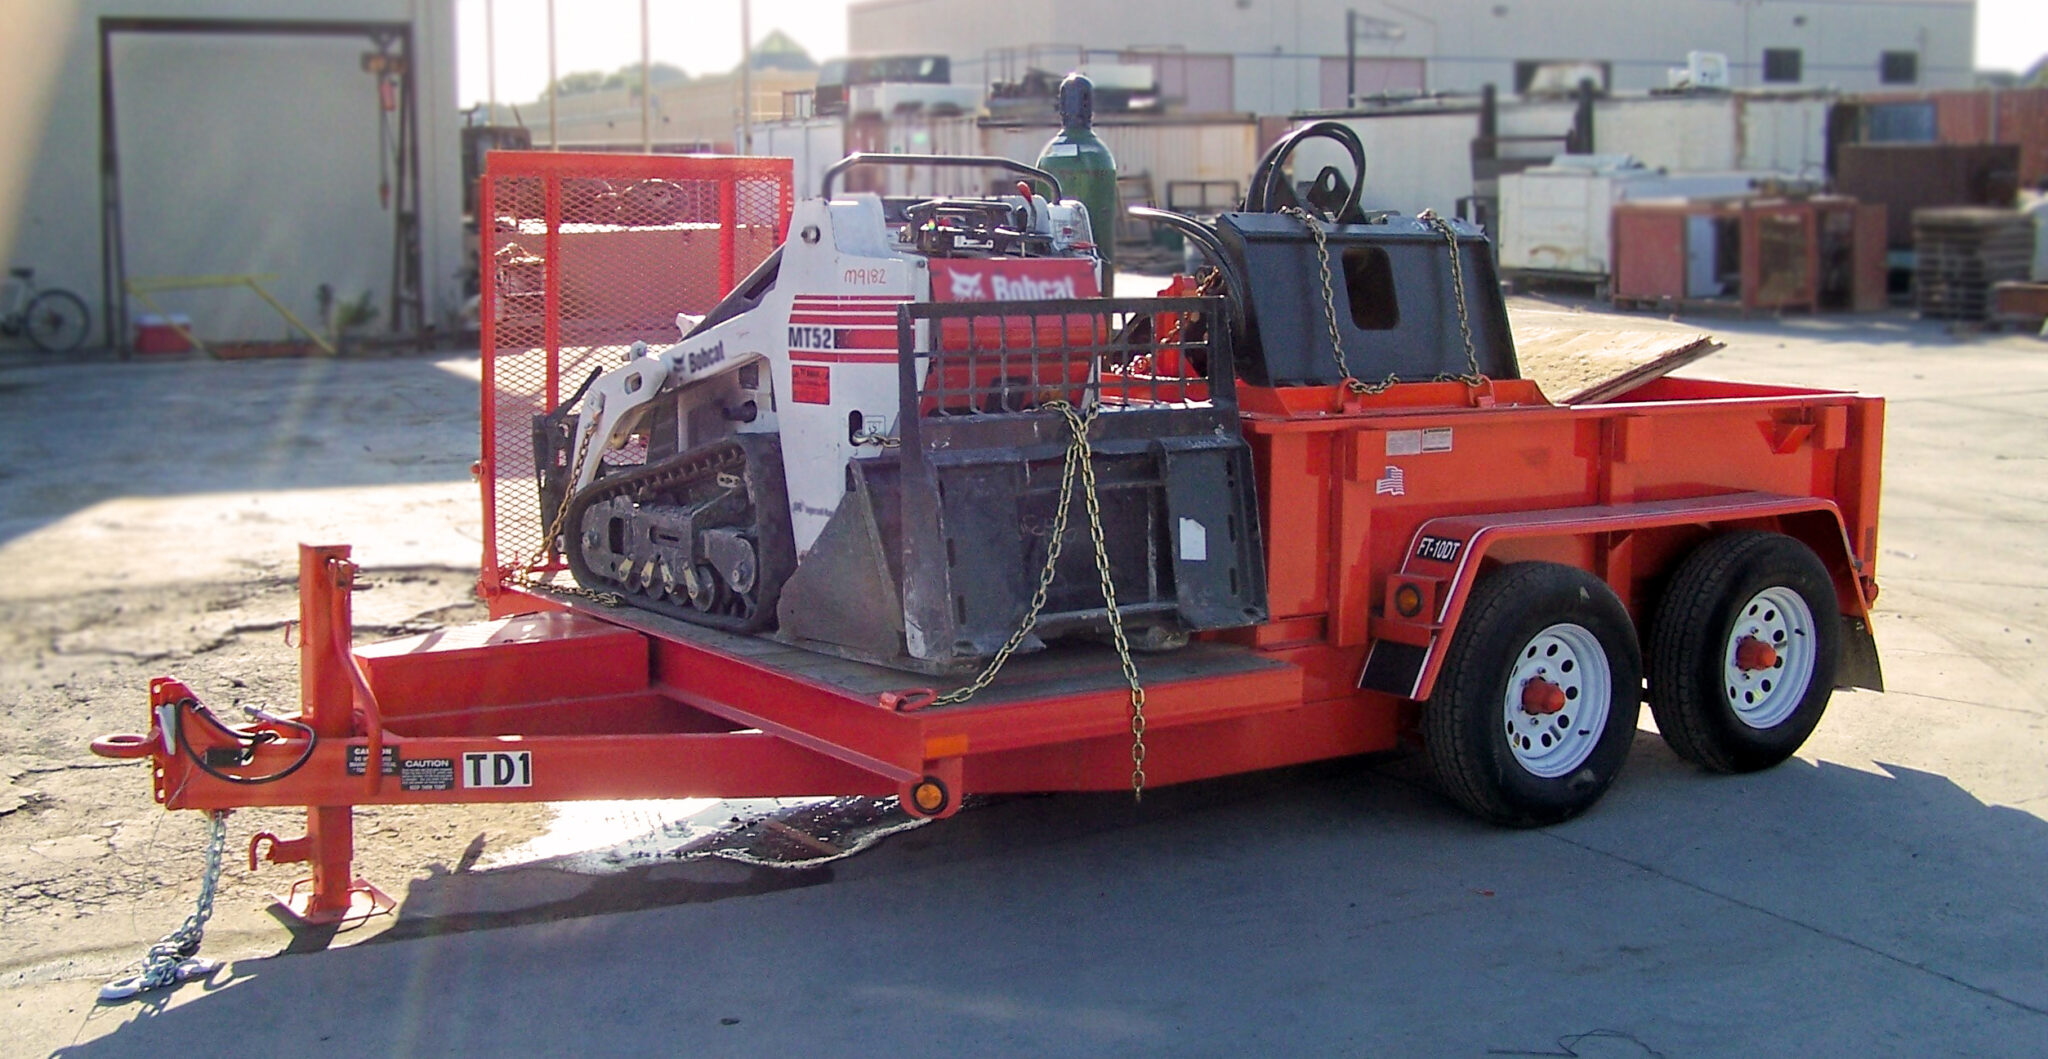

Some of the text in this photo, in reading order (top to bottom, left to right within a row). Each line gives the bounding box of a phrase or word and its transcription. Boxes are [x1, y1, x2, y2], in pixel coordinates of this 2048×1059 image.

[788, 327, 832, 350] MT52
[688, 339, 725, 374] Bobcat
[1417, 536, 1461, 561] FT-10DT
[405, 759, 449, 768] CAUTION
[465, 752, 530, 786] TD1
